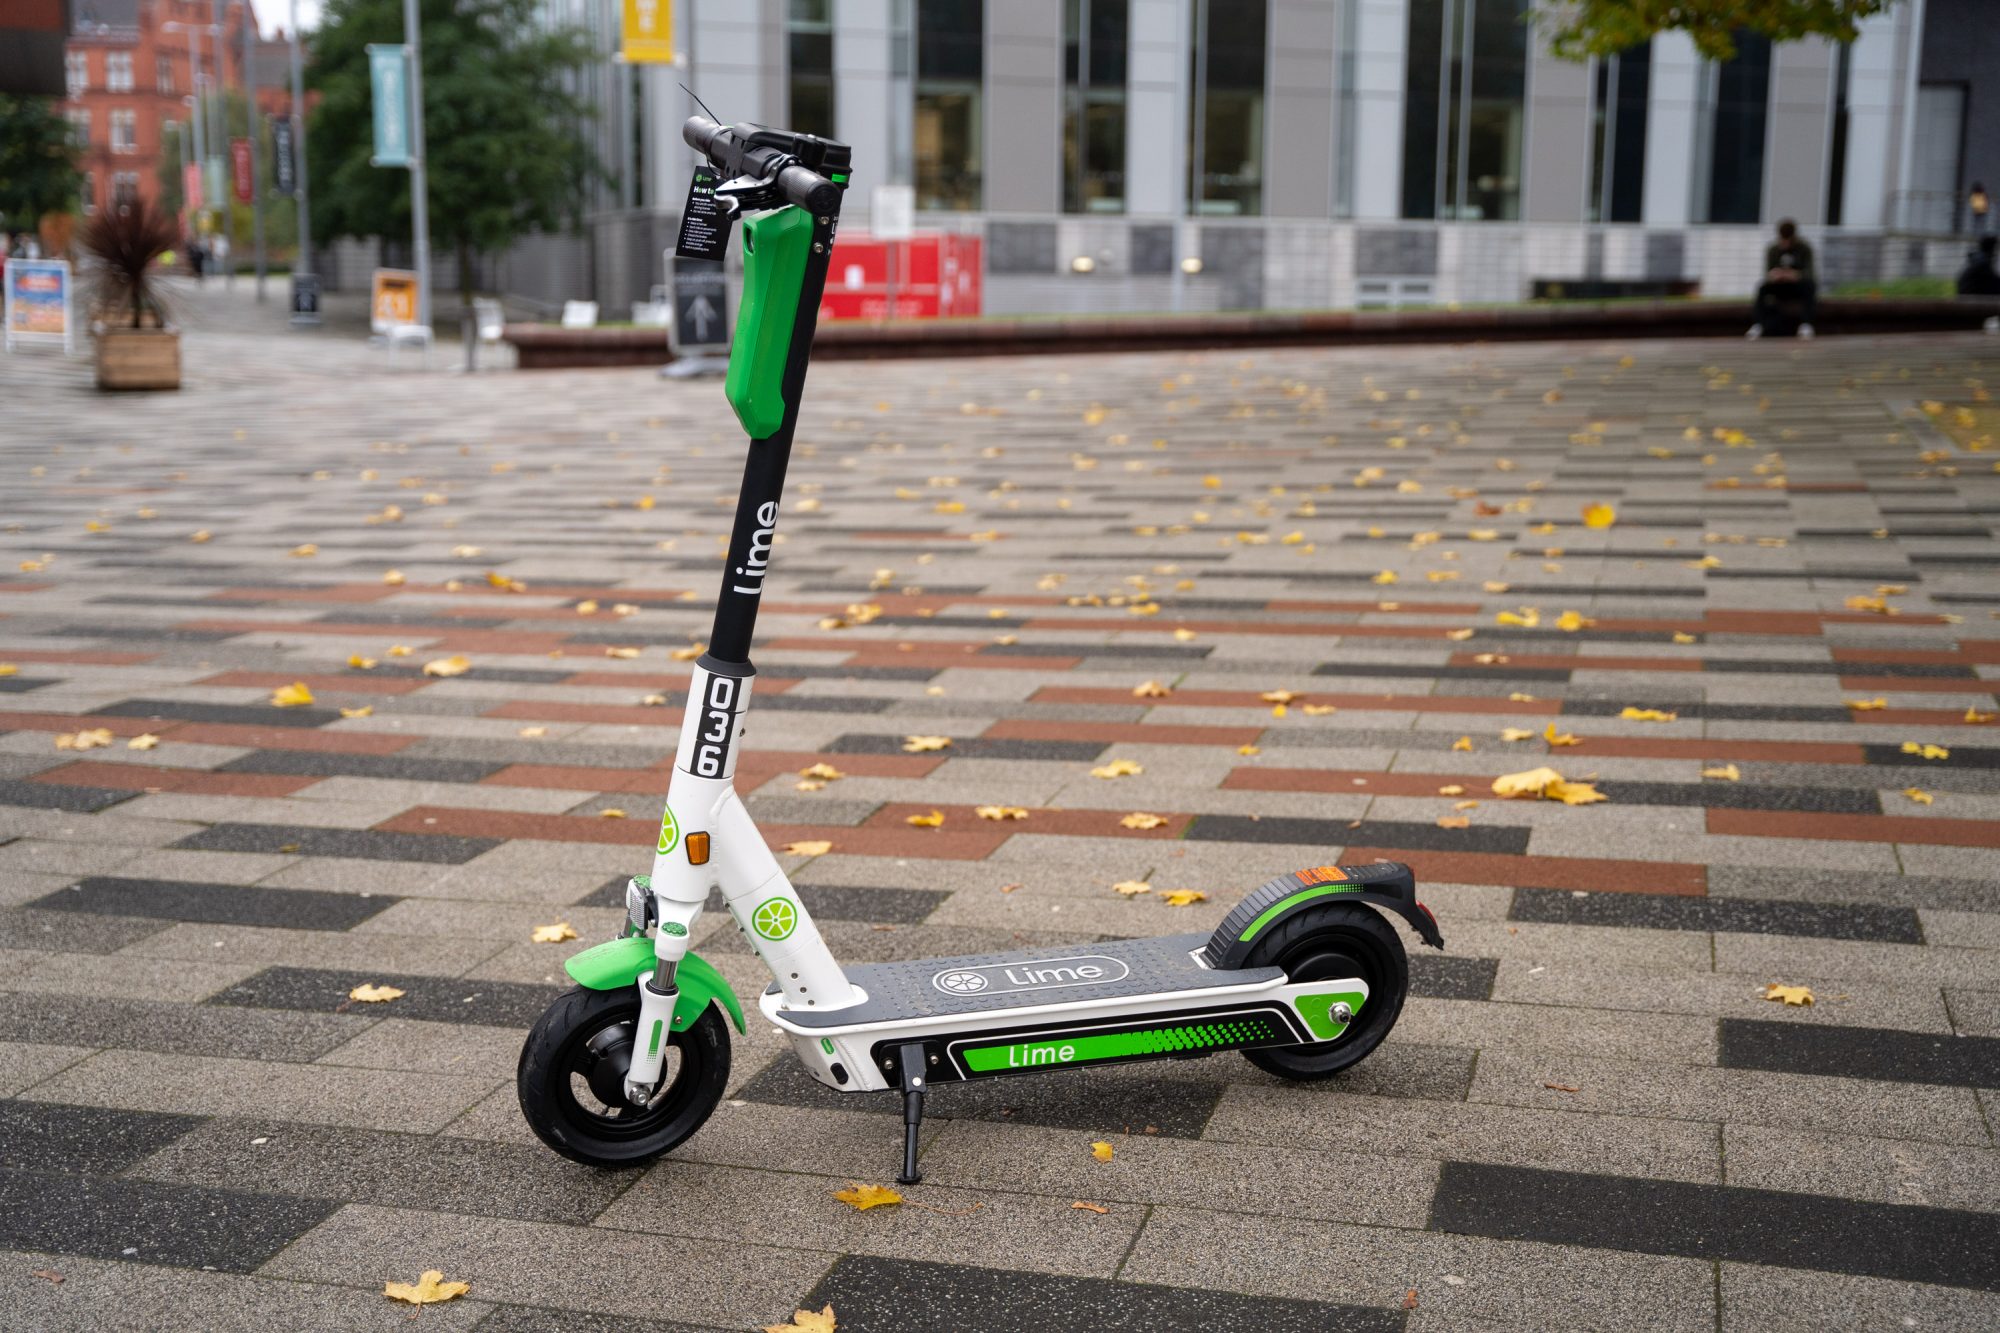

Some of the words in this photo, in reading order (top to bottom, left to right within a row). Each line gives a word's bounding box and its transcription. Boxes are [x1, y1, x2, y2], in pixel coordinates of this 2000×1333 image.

[694, 186, 707, 194] How
[733, 501, 779, 595] Lime
[696, 677, 735, 777] 036
[1004, 965, 1104, 986] Lime
[1009, 1044, 1075, 1068] Lime
